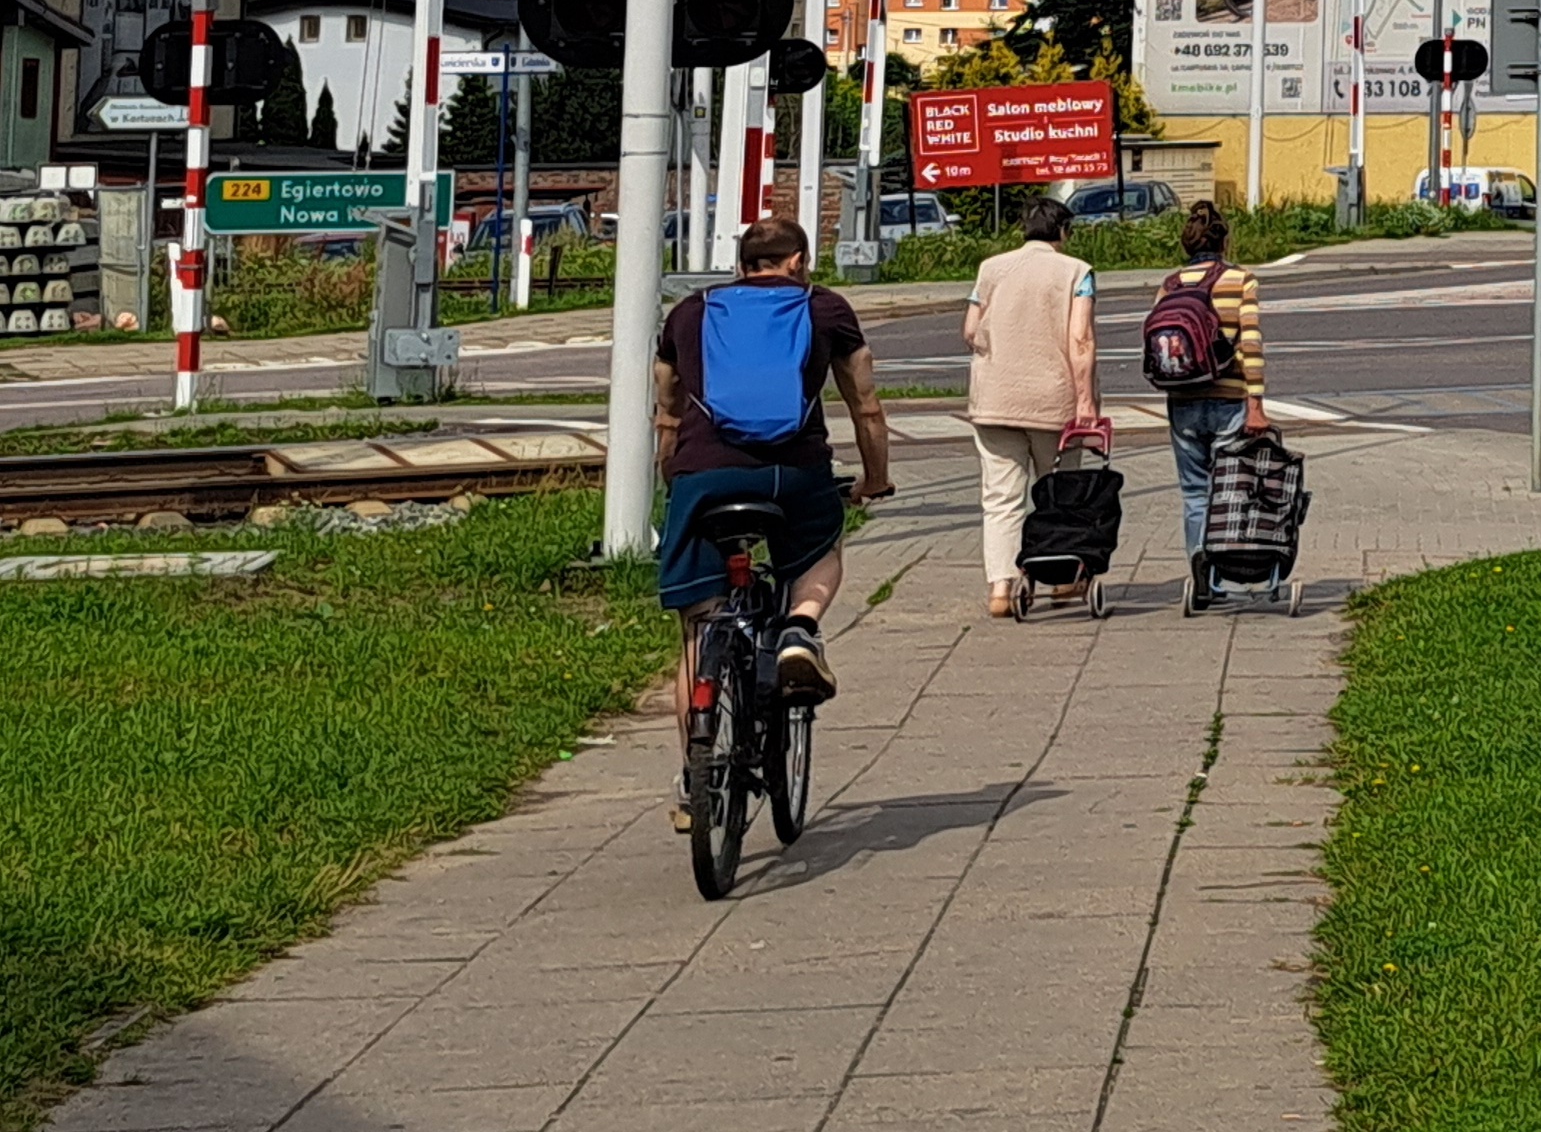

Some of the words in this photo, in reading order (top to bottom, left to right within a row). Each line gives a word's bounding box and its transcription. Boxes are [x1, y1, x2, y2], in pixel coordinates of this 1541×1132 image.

[1204, 43, 1230, 57] 692
[1171, 82, 1237, 95] kmebike.pl
[925, 104, 970, 118] BLACK
[987, 101, 1030, 117] Salon
[1034, 97, 1103, 115] meblowy
[926, 119, 954, 132] RED
[926, 132, 973, 145] WHITE
[994, 127, 1044, 143] Studio
[1049, 124, 1099, 140] kuchni
[231, 183, 262, 197] 224
[281, 180, 384, 203] Egiertowo
[280, 205, 338, 224] Nowa
